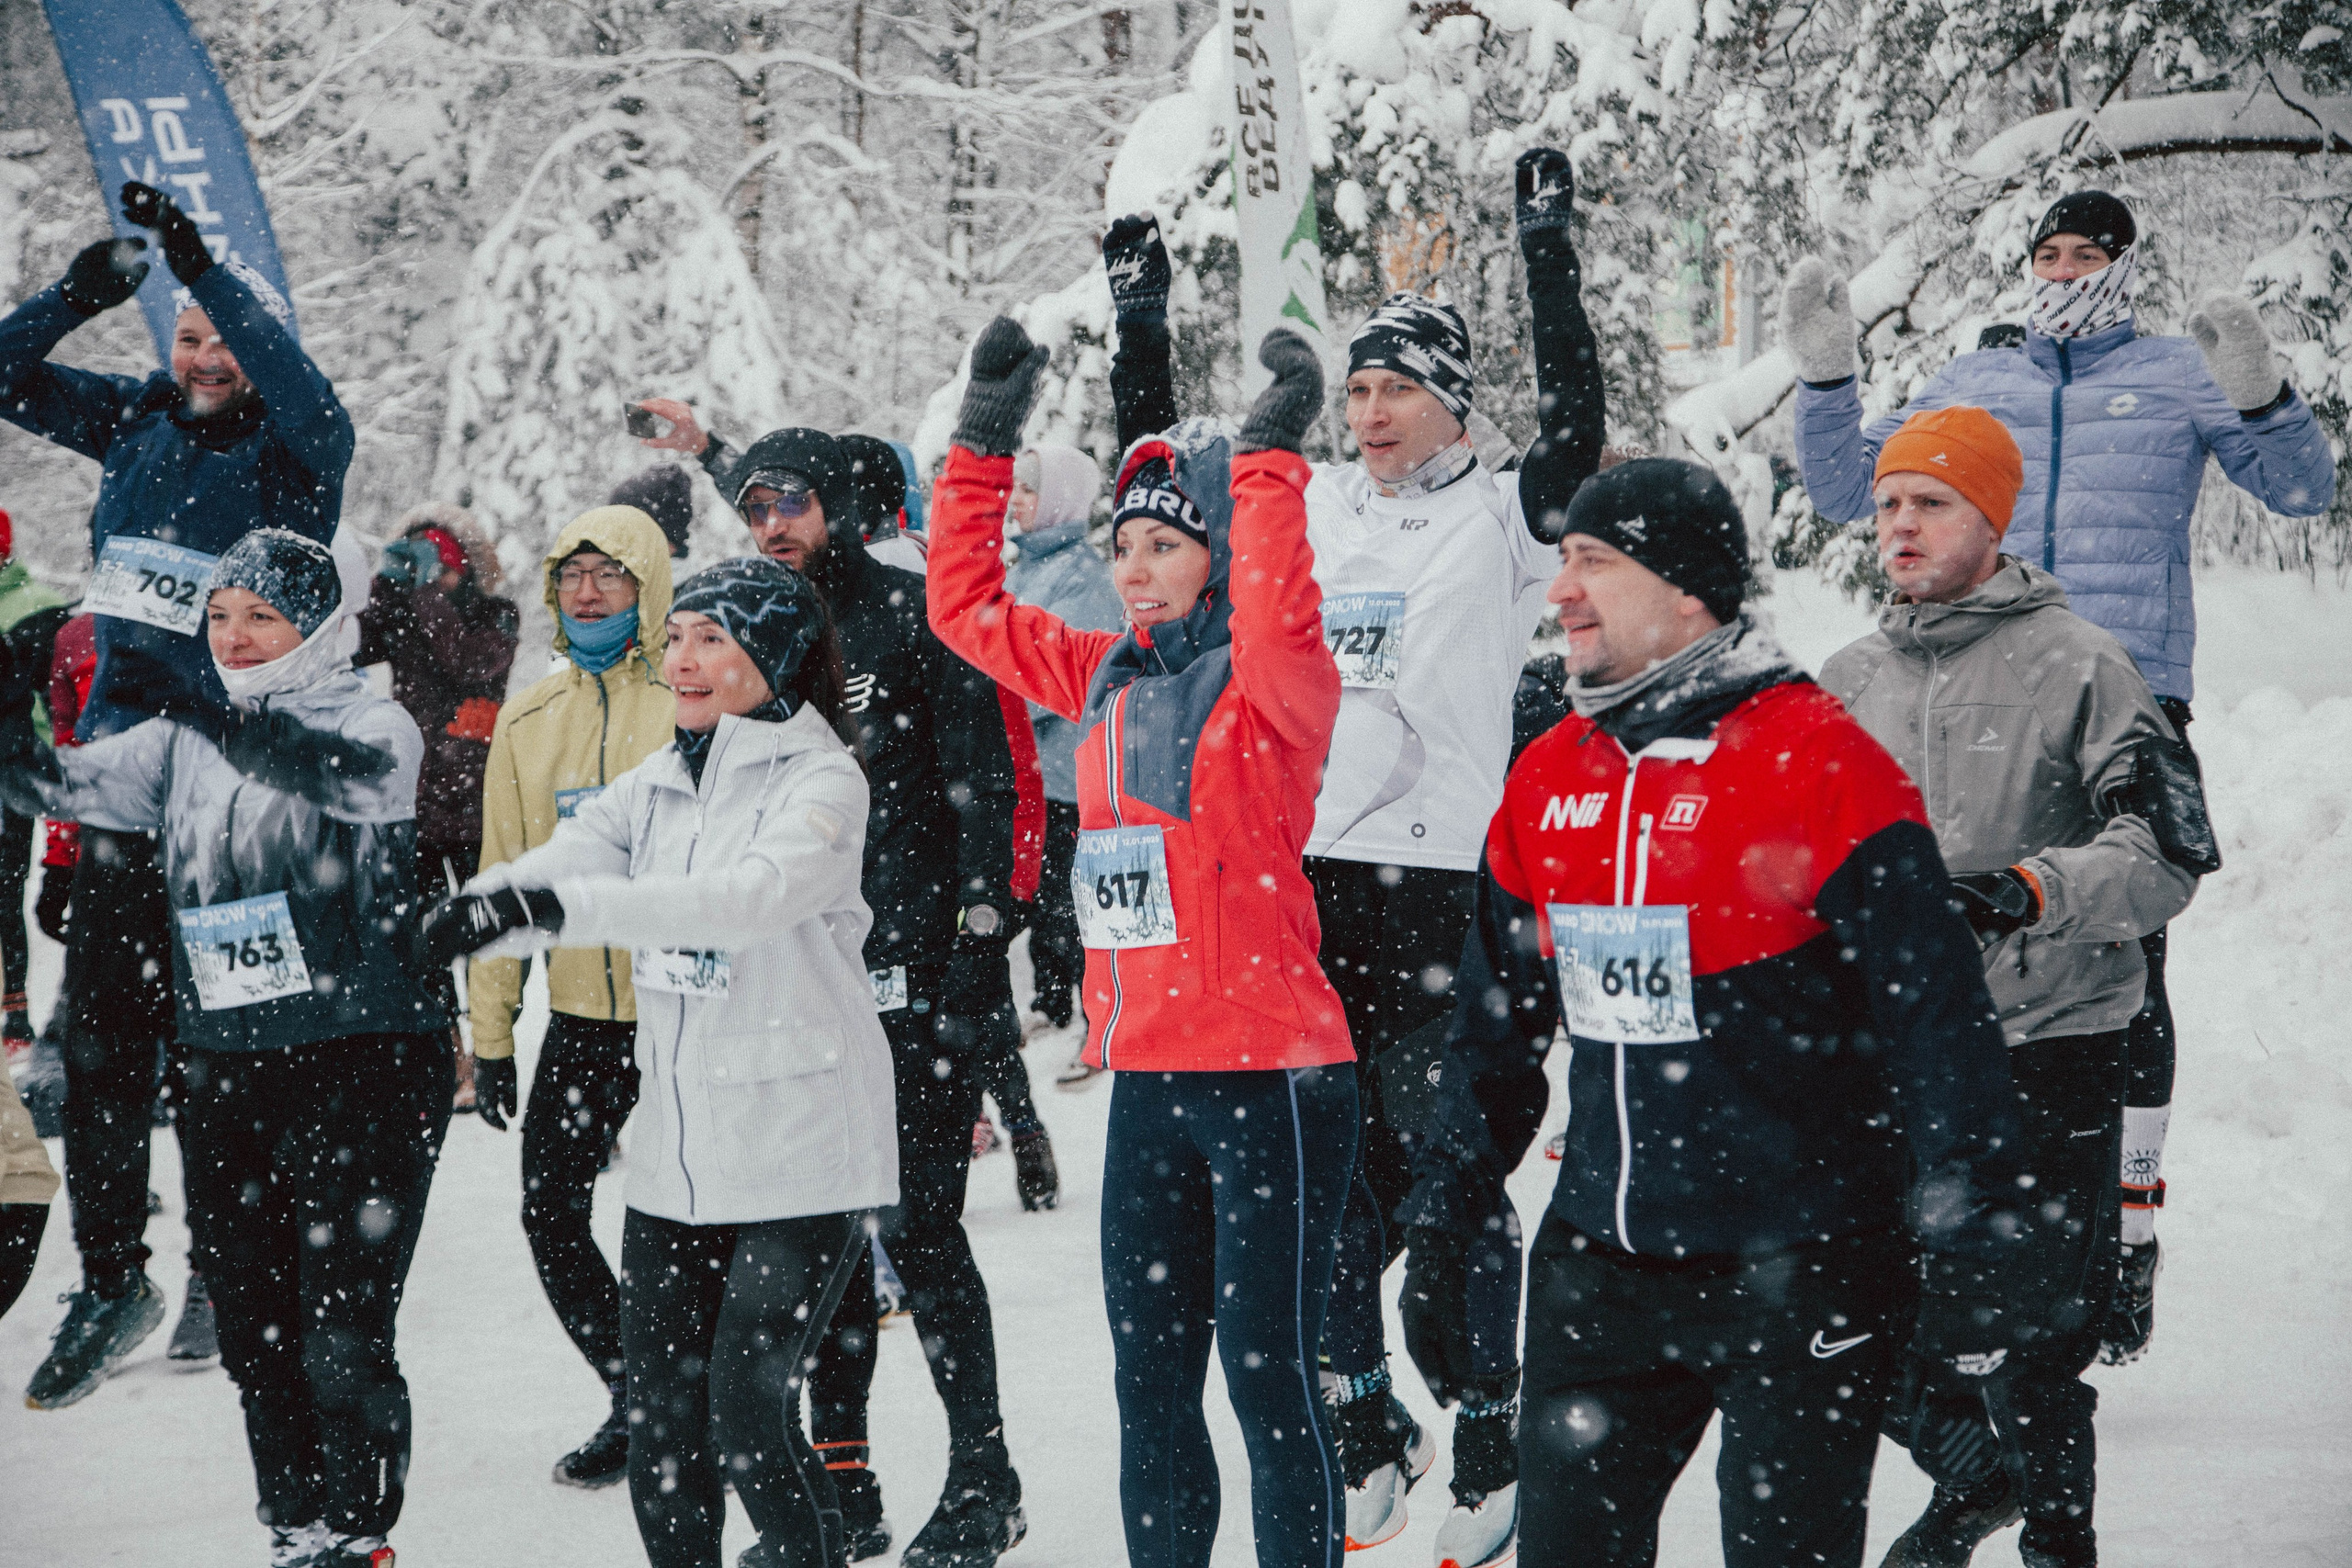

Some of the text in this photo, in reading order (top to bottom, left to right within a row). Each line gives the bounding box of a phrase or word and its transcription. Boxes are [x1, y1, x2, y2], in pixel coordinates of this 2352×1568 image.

[1114, 488, 1206, 531] BRU
[134, 540, 184, 563] SNOW
[138, 569, 198, 607] 702
[1323, 595, 1366, 615] SNOW
[1330, 626, 1386, 656] 727
[1096, 871, 1150, 909] 617
[199, 904, 246, 928] SNOW
[1580, 911, 1637, 935] SNOW
[219, 932, 284, 971] 763
[1601, 958, 1672, 998] 616
